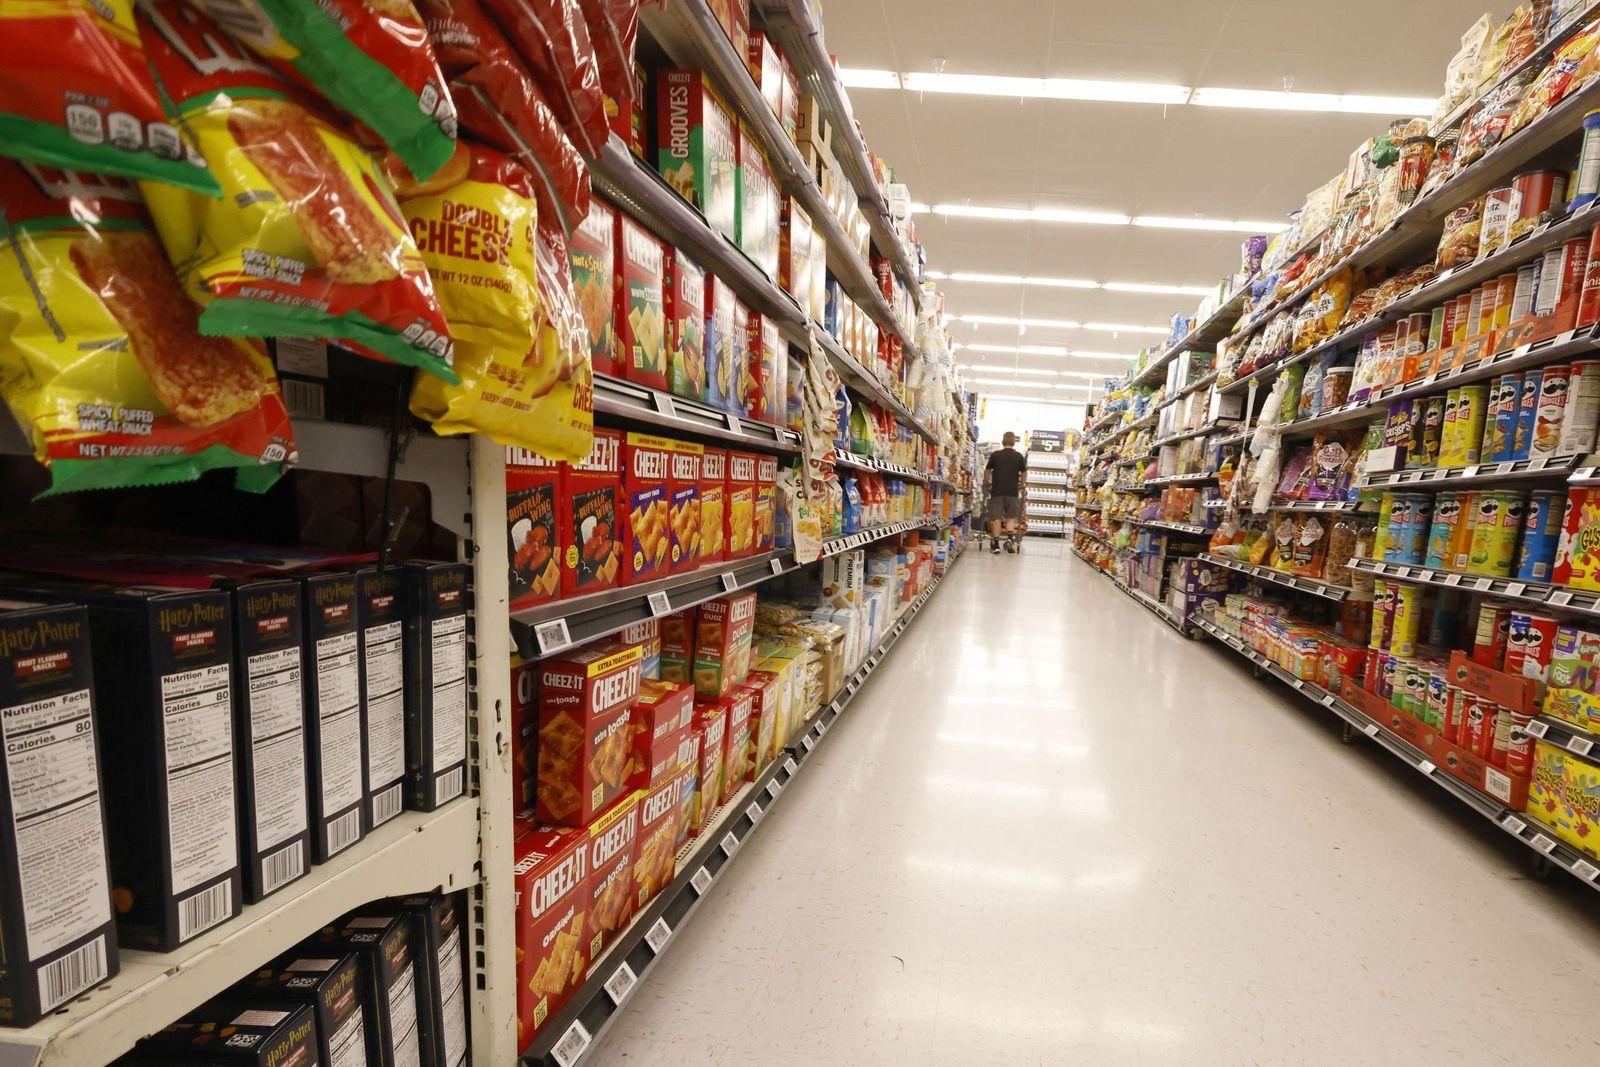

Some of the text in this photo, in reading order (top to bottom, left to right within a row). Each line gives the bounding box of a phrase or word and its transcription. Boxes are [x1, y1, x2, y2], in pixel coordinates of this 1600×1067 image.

[670, 86, 690, 159] GROOVES
[572, 254, 584, 266] HOT
[441, 271, 456, 283] WT
[458, 274, 471, 284] 12
[472, 276, 485, 288] OZ
[77, 403, 154, 423] SPICY PUFFED
[80, 416, 152, 436] WHEAT SNACK
[79, 444, 108, 458] NET
[508, 492, 542, 522] BUFFALO
[530, 498, 551, 523] WING
[579, 494, 605, 519] BUFFALO
[596, 500, 612, 520] WING
[248, 590, 296, 618] Harry Potter
[160, 602, 225, 633] Harry Potter
[704, 614, 722, 622] DUOZ
[37, 619, 81, 648] Potter
[176, 634, 190, 644] FRUIT
[366, 624, 388, 635] Nutrition
[732, 624, 748, 642] DUOZ
[317, 632, 357, 648] Nutrition Facts
[250, 648, 299, 664] Nutrition Facts
[366, 647, 387, 658] Calories
[598, 651, 637, 672] EXTRA TOASTINESS
[18, 658, 36, 669] FRUIT
[32, 662, 56, 672] SNACKS
[318, 660, 341, 671] Calories
[164, 666, 228, 684] Nutrition Facts
[250, 670, 300, 690] Calories 80
[4, 692, 89, 718] Nutrition Facts
[165, 690, 228, 714] Calories 80
[556, 696, 580, 704] toasty
[5, 723, 32, 734] Serving
[8, 720, 91, 752] Calories 80
[594, 709, 631, 745] extra toasty
[1565, 786, 1598, 814] Gushers
[598, 816, 612, 830] EXTRA
[594, 854, 630, 899] extra toasty
[324, 982, 342, 1008] Harry
[266, 1018, 312, 1067] Harry Potter
